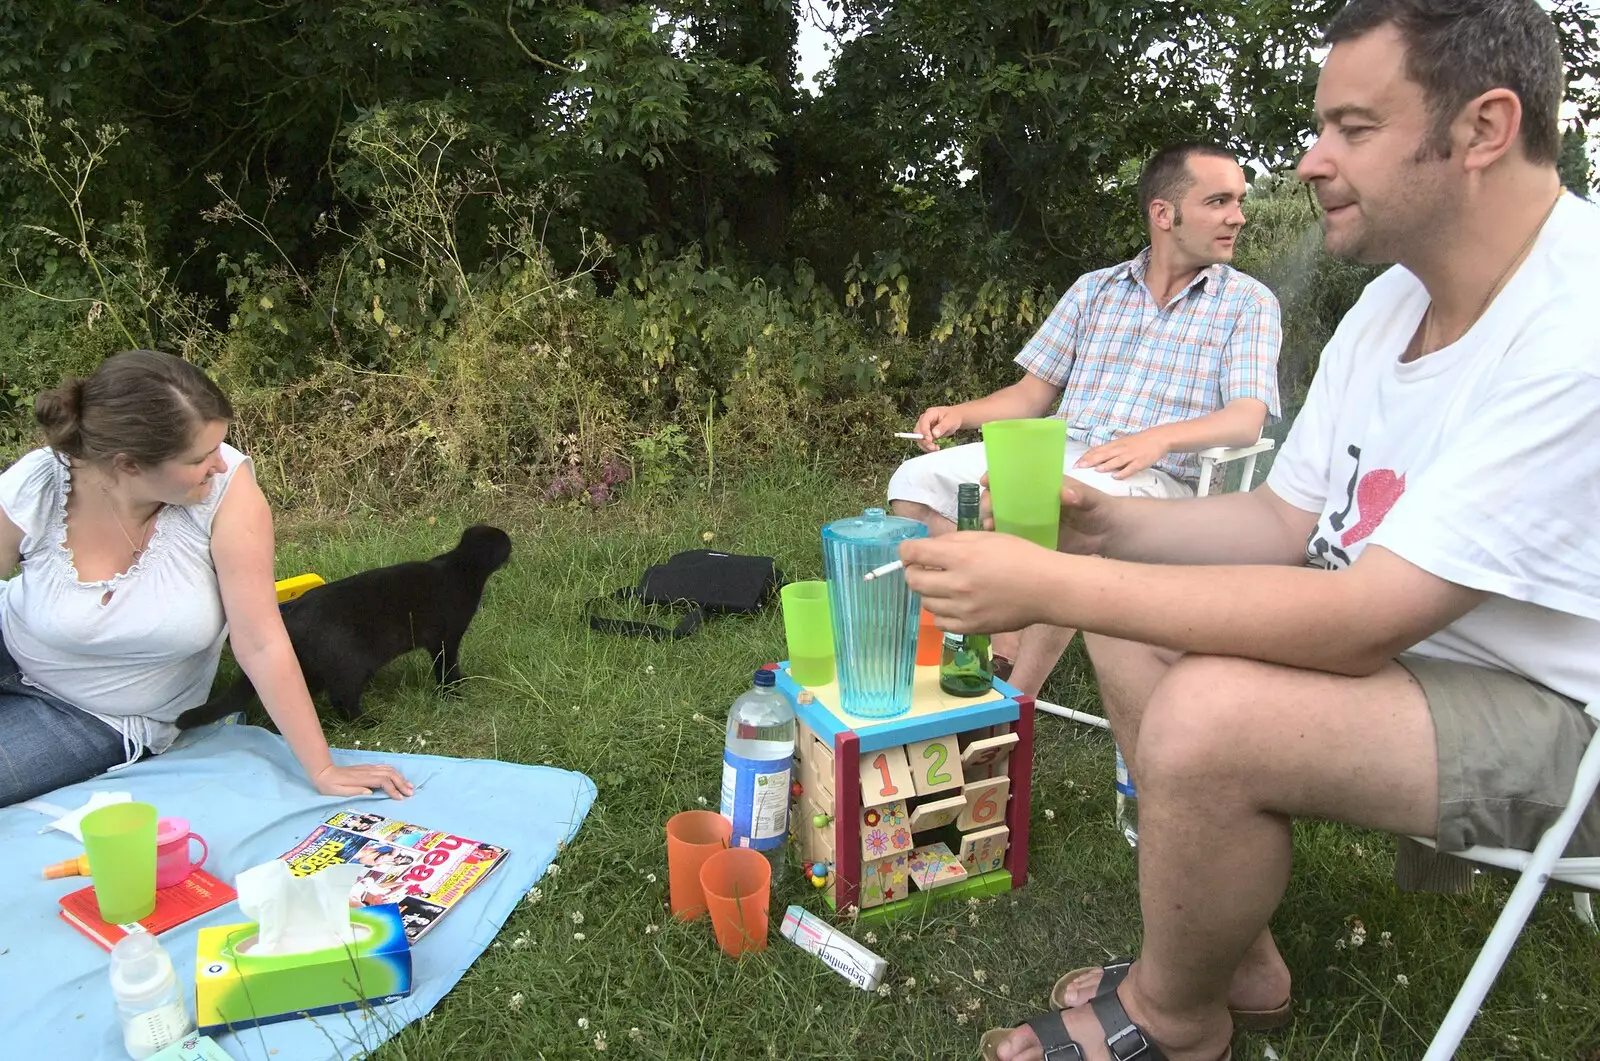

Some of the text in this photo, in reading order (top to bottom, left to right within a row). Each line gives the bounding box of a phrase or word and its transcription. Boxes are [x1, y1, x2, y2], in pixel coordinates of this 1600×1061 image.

[873, 753, 898, 797] 1
[923, 743, 952, 786] 2
[972, 788, 998, 823] 6
[818, 947, 866, 986] Bepanthen
